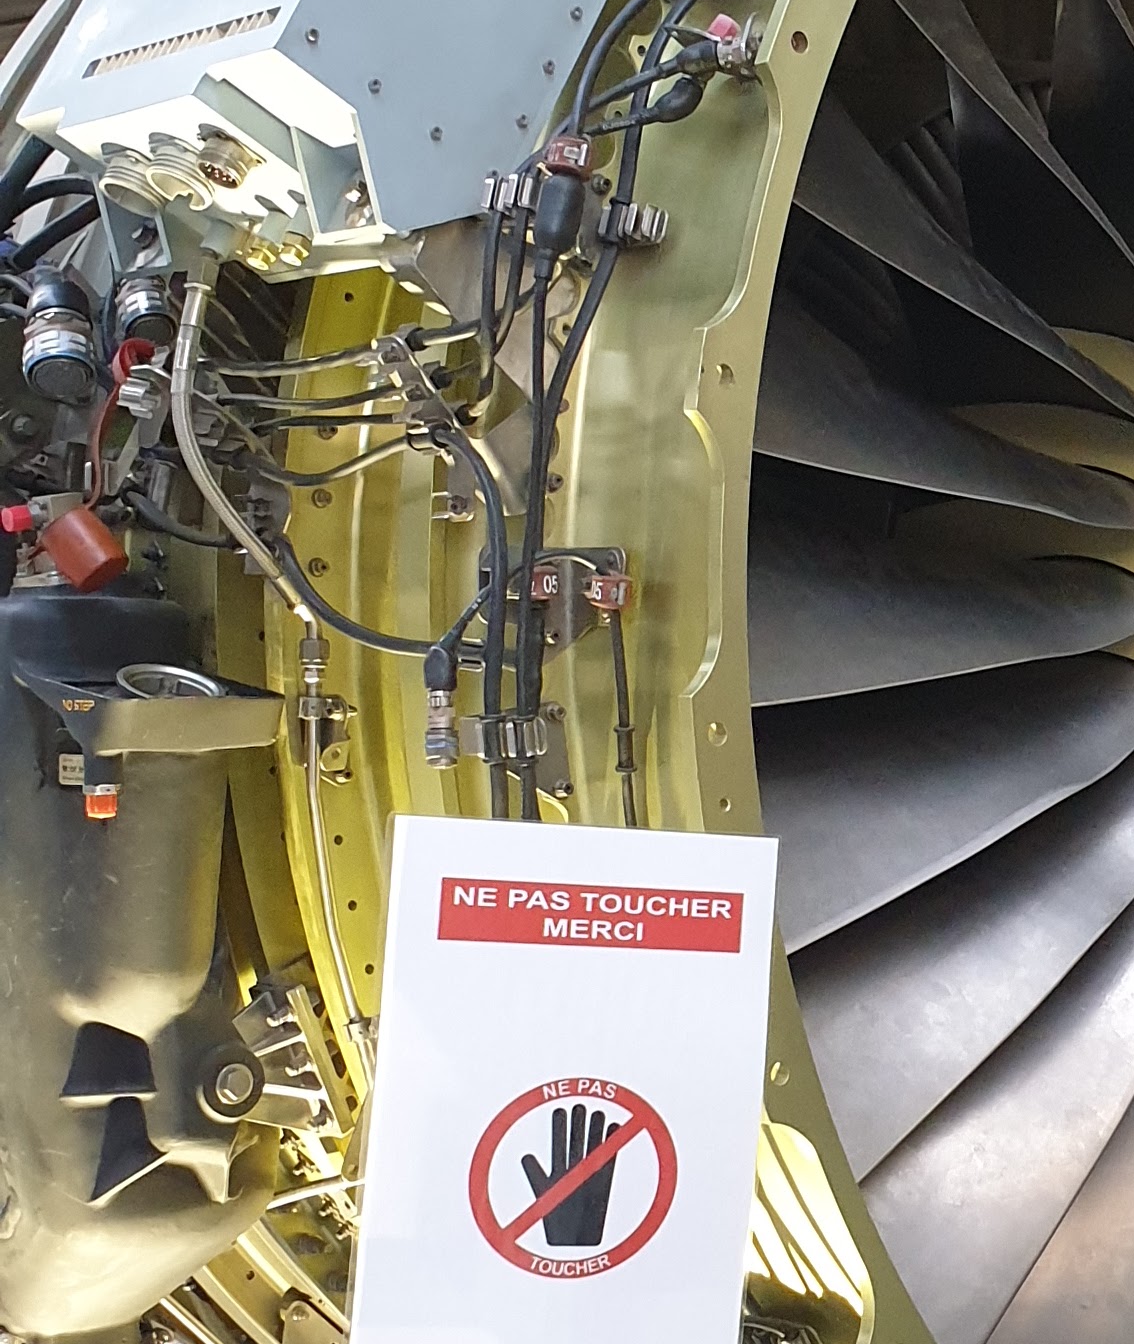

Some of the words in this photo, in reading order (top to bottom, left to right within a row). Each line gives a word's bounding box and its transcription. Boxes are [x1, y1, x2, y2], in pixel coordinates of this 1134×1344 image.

[543, 575, 559, 594] 05
[453, 885, 498, 907] NE
[508, 888, 570, 912] PAS
[580, 891, 732, 919] TOUCHER
[542, 917, 643, 942] MERCI
[542, 1079, 570, 1100] NE
[577, 1078, 617, 1100] PAS
[530, 1254, 611, 1276] TOUCHER
